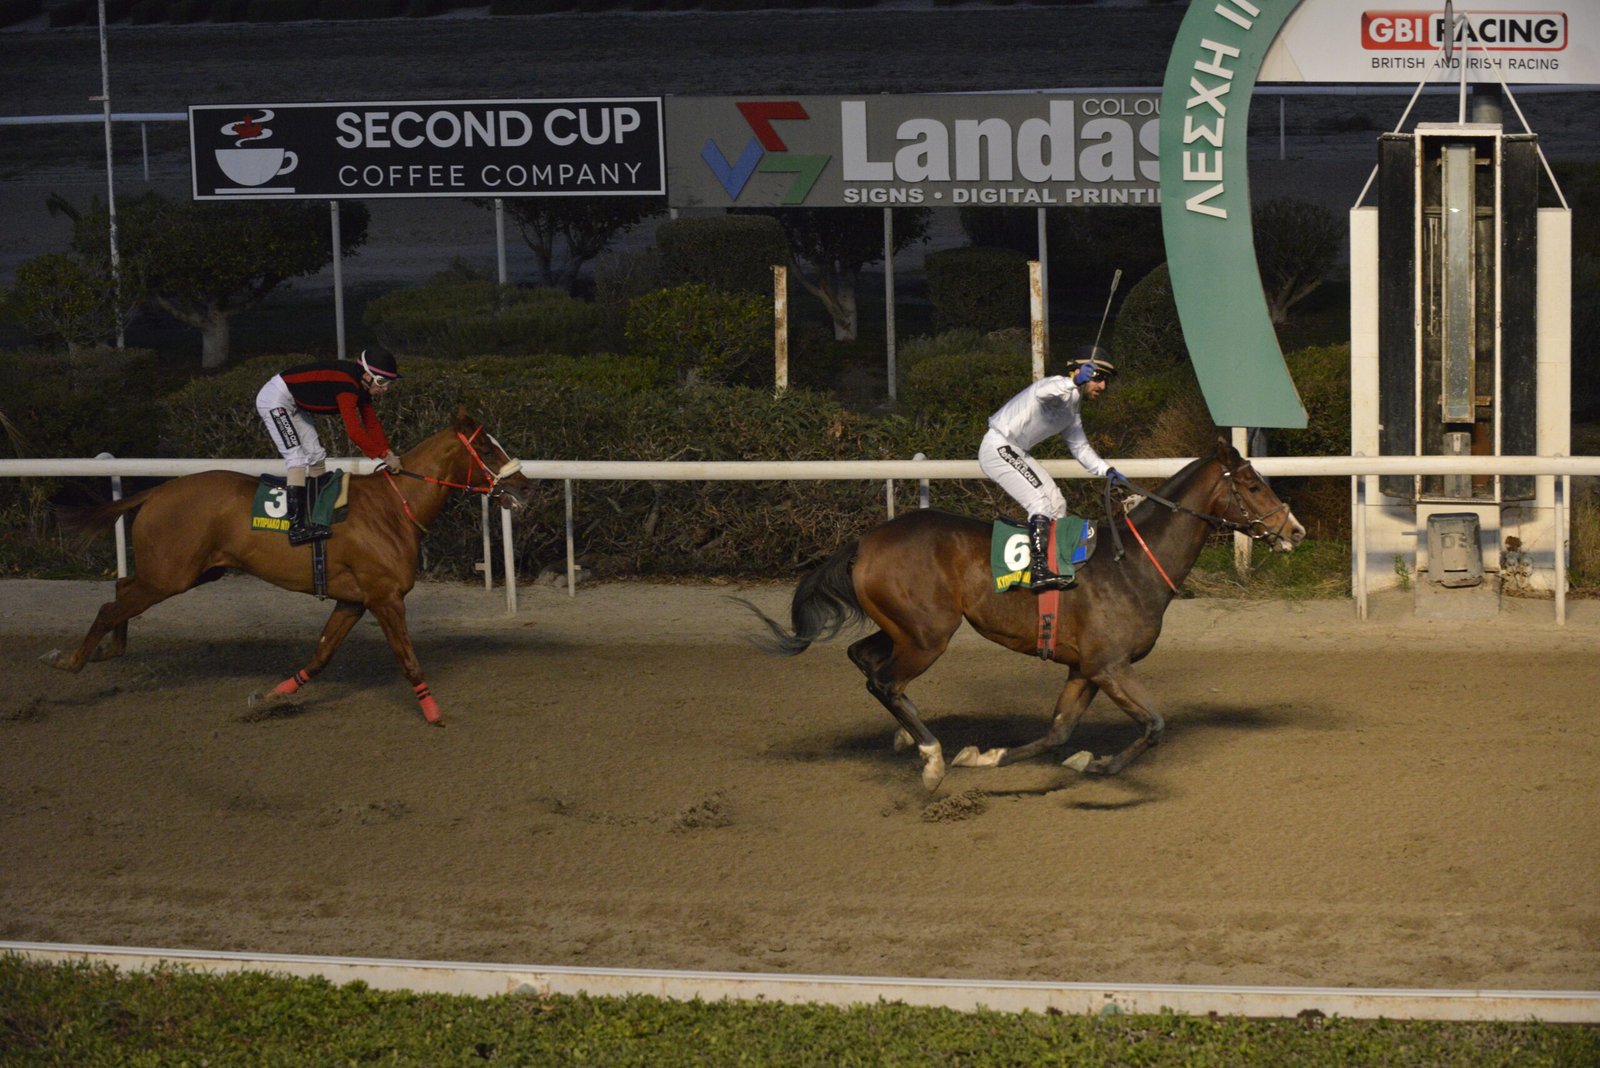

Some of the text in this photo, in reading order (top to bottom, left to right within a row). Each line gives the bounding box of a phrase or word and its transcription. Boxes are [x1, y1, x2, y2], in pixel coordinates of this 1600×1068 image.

[1368, 17, 1423, 43] GBI
[1371, 57, 1559, 70] BRITISH AND IRISH RACING
[335, 107, 642, 149] SECOND CUP
[1183, 38, 1241, 219] ΛΕΣΧΗ
[338, 162, 642, 188] COFFEE COMPANY
[843, 188, 1161, 204] SIGNS DIGITAL PRINTI
[264, 487, 288, 518] 3
[1004, 533, 1031, 571] 6
